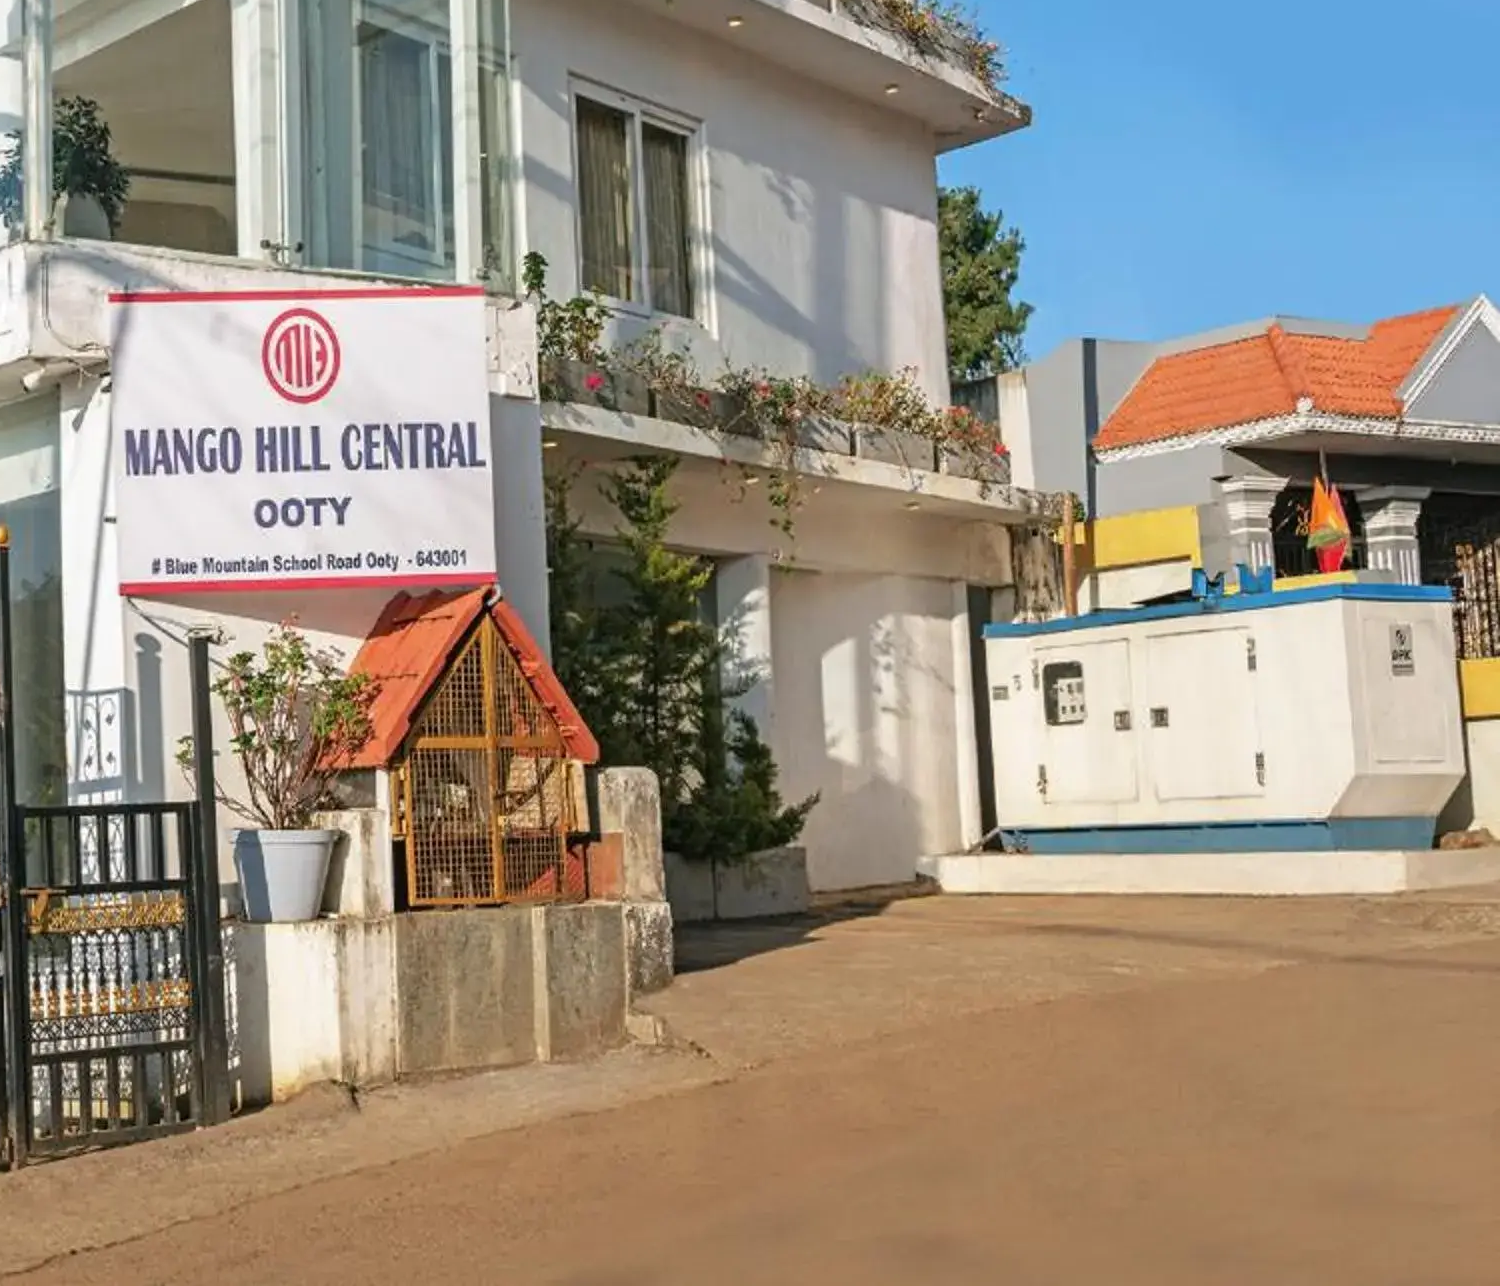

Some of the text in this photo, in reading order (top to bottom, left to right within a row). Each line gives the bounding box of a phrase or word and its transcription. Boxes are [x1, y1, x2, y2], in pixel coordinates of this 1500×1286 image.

[125, 422, 486, 476] MANGO HILL CENTRAL
[254, 497, 352, 528] OOTY
[165, 557, 198, 575] Blue
[202, 555, 269, 574] Mountain
[272, 553, 323, 572] School
[327, 552, 362, 570] Road
[366, 551, 399, 572] Ooty
[416, 549, 467, 568] 643001
